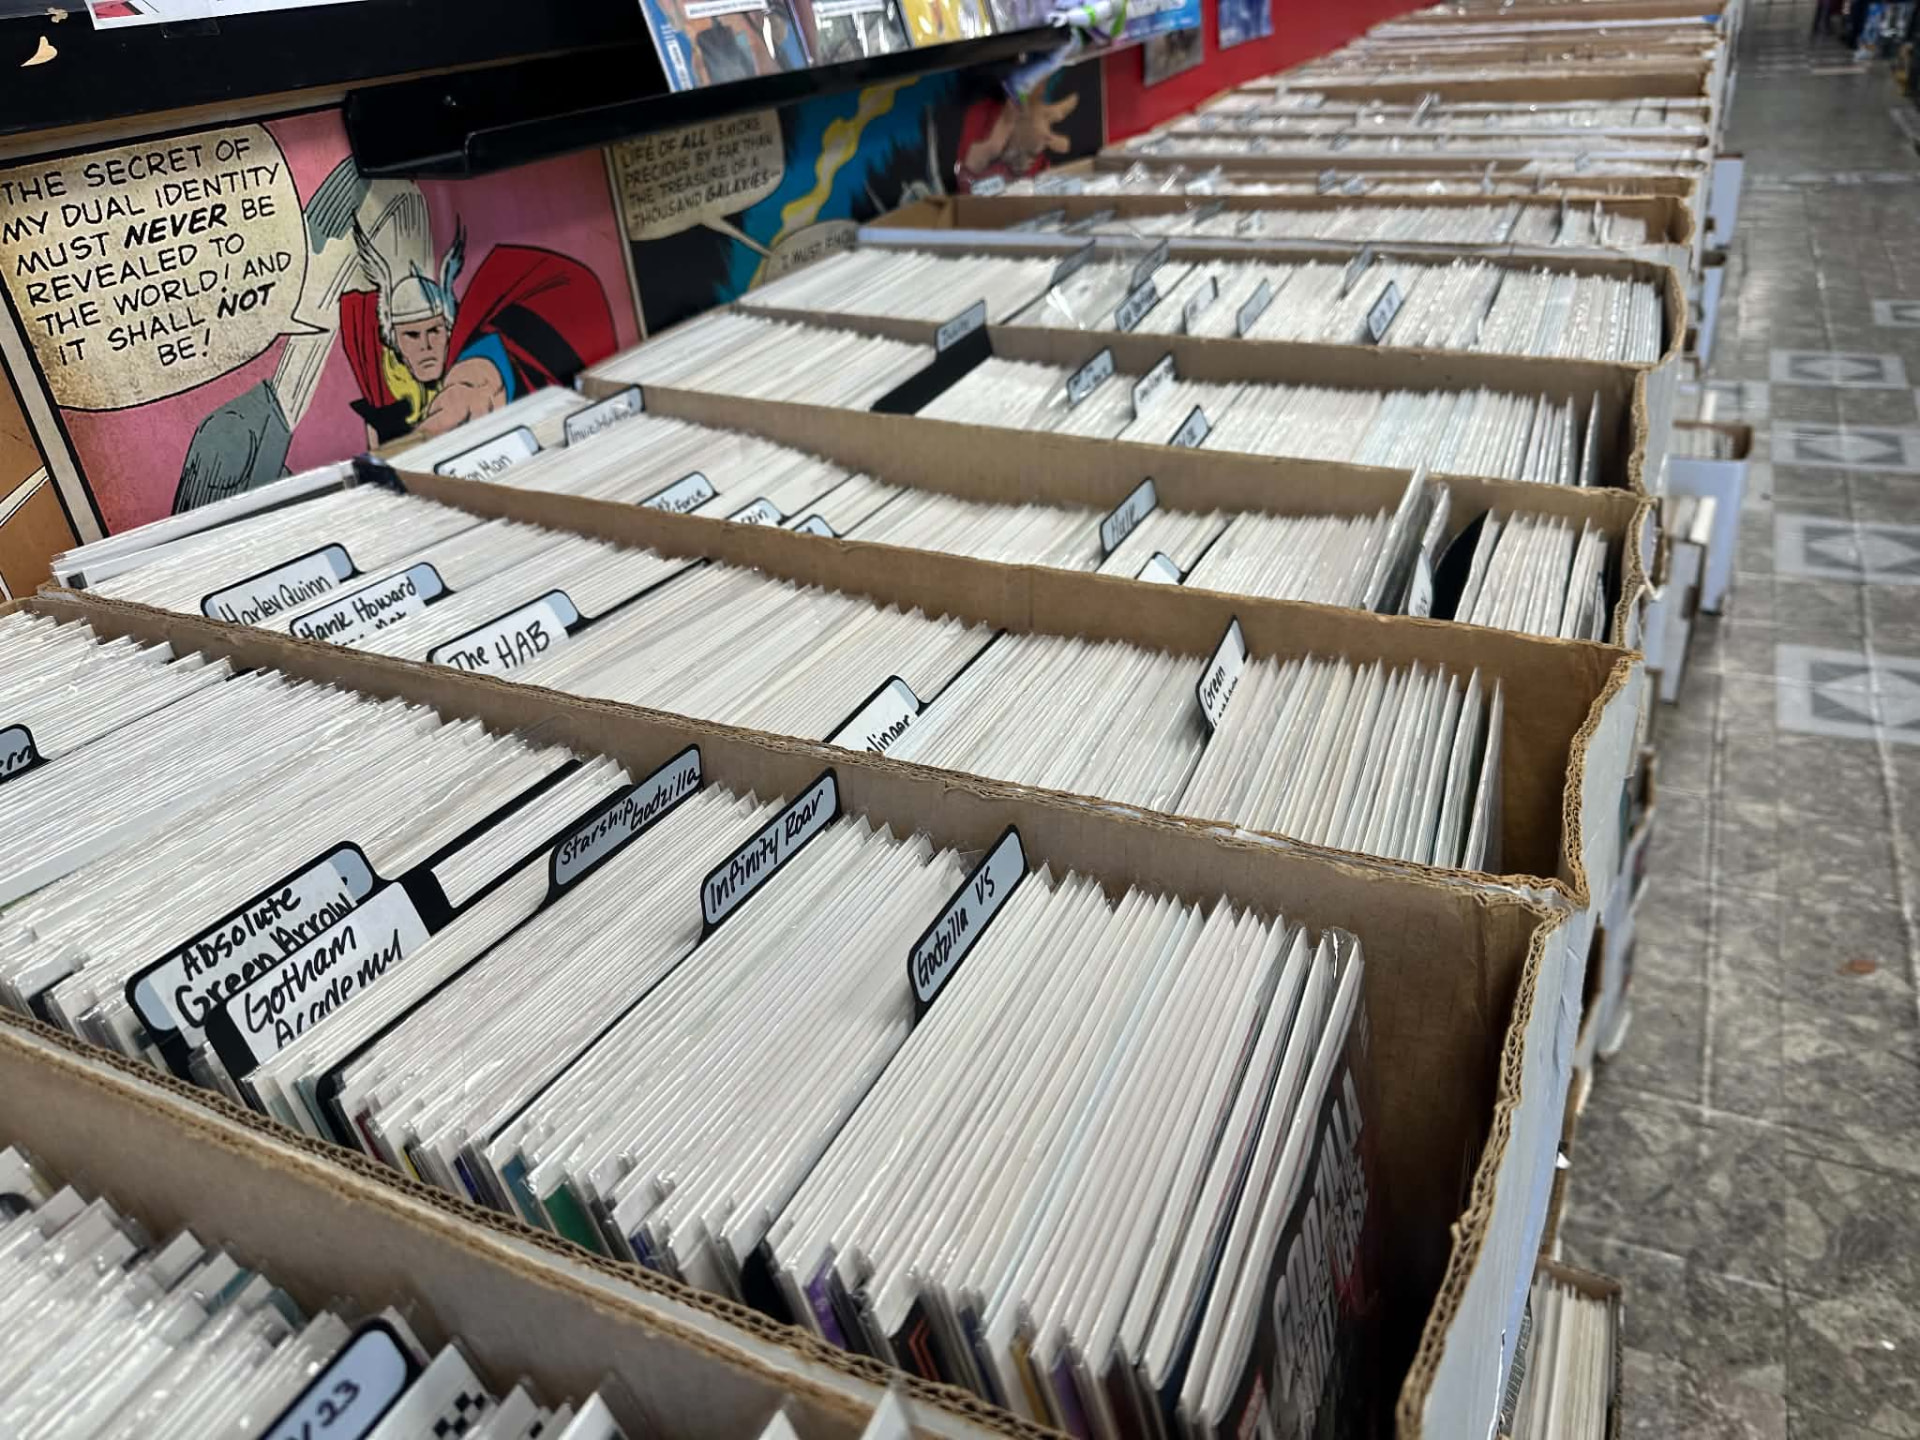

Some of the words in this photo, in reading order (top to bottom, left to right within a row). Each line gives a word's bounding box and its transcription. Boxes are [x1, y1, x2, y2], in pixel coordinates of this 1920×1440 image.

[1, 171, 67, 205] THE
[83, 145, 203, 188] SECRET
[215, 138, 250, 163] OF
[624, 155, 690, 187] PRECIOUS
[696, 149, 712, 167] BY
[682, 128, 708, 150] ALL
[2, 211, 49, 245] MY
[61, 194, 146, 229] DUAL
[155, 162, 280, 209] IDENTITY
[628, 186, 656, 207] THE
[658, 164, 728, 196] TREASURE
[631, 191, 702, 228] THOUSAND
[16, 232, 110, 276] MUST
[124, 203, 229, 249] NEVER
[241, 195, 276, 221] BE
[26, 244, 198, 308] REVEALED
[209, 233, 245, 258] TO
[36, 301, 101, 337] THE
[113, 262, 229, 316] WORLD!
[243, 251, 292, 280] AND
[59, 338, 86, 366] IT
[108, 307, 205, 351] SHALL
[217, 282, 276, 319] NOT
[157, 328, 211, 366] BE!
[299, 611, 353, 641] Hank
[352, 576, 416, 622] Howard
[447, 645, 490, 672] The
[497, 619, 552, 669] HAB
[560, 796, 634, 866] Starship
[709, 831, 780, 914] Infinity
[785, 789, 825, 847] Roar
[174, 953, 279, 1029] Green
[269, 892, 351, 957] Arrow
[181, 887, 301, 982] Absolute
[915, 907, 969, 990] Godzilla
[974, 865, 996, 906] VS
[244, 925, 357, 1033] Gotham
